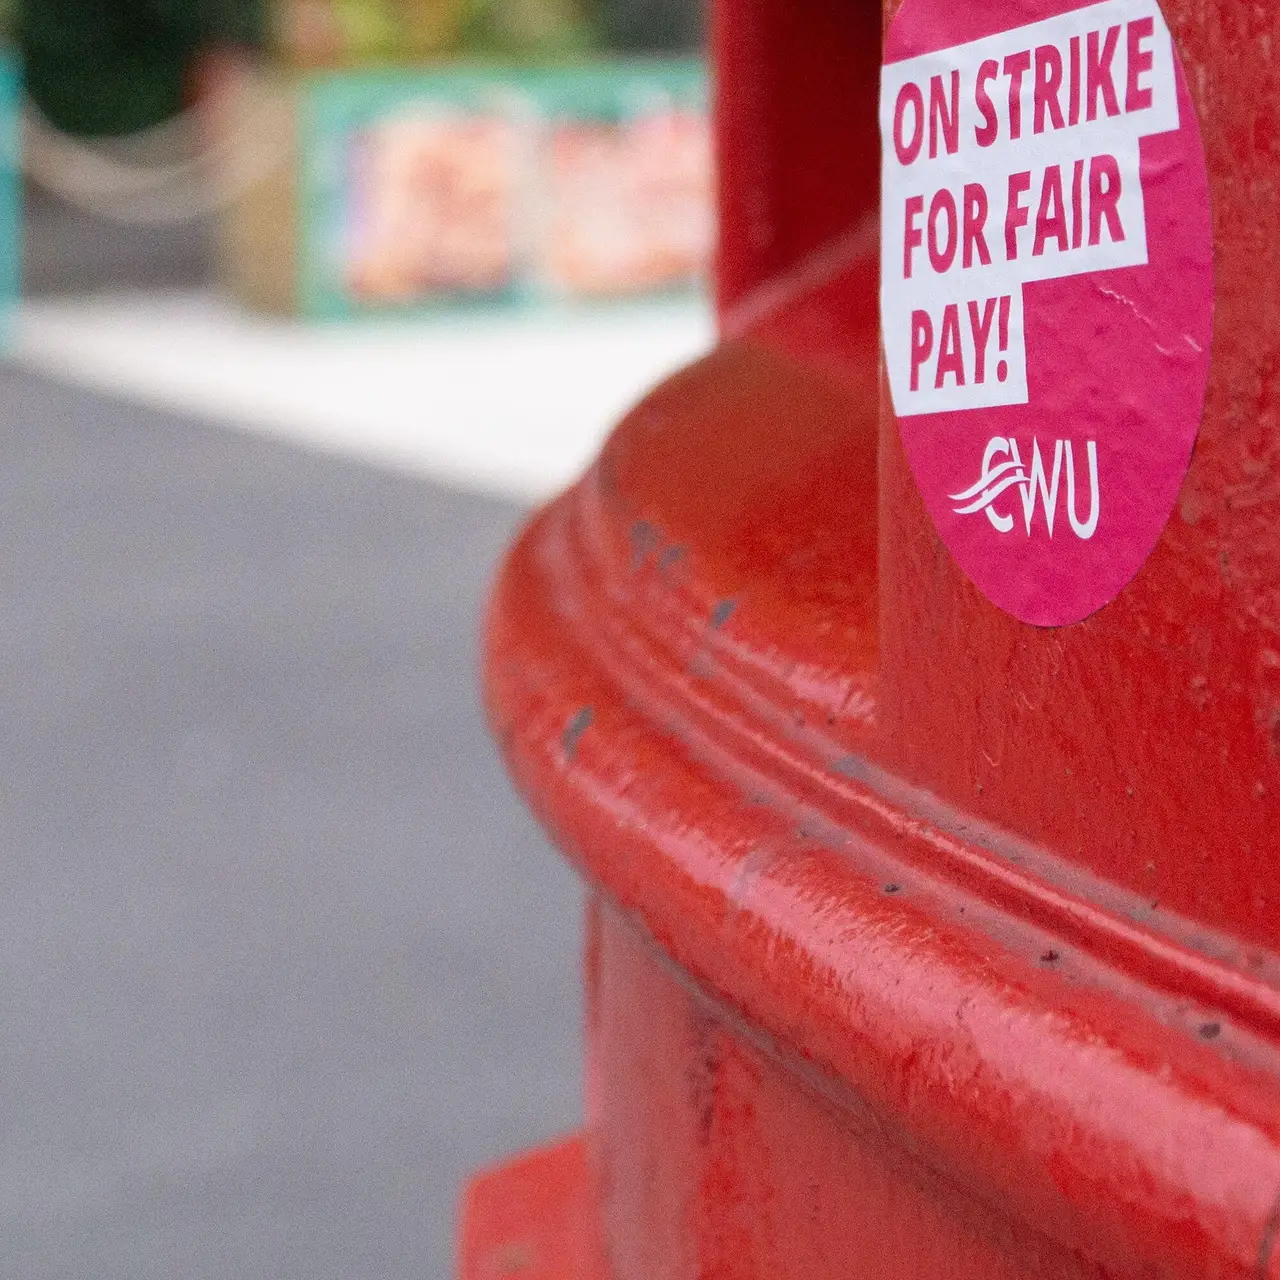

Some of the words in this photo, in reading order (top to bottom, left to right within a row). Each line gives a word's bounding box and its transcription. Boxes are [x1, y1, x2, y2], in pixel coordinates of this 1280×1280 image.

[892, 68, 960, 166] ON
[974, 16, 1155, 147] STRIKE
[903, 188, 989, 280] FOR
[1004, 154, 1125, 261] FAIR
[908, 295, 1011, 391] PAY!
[948, 436, 1100, 540] CWU
